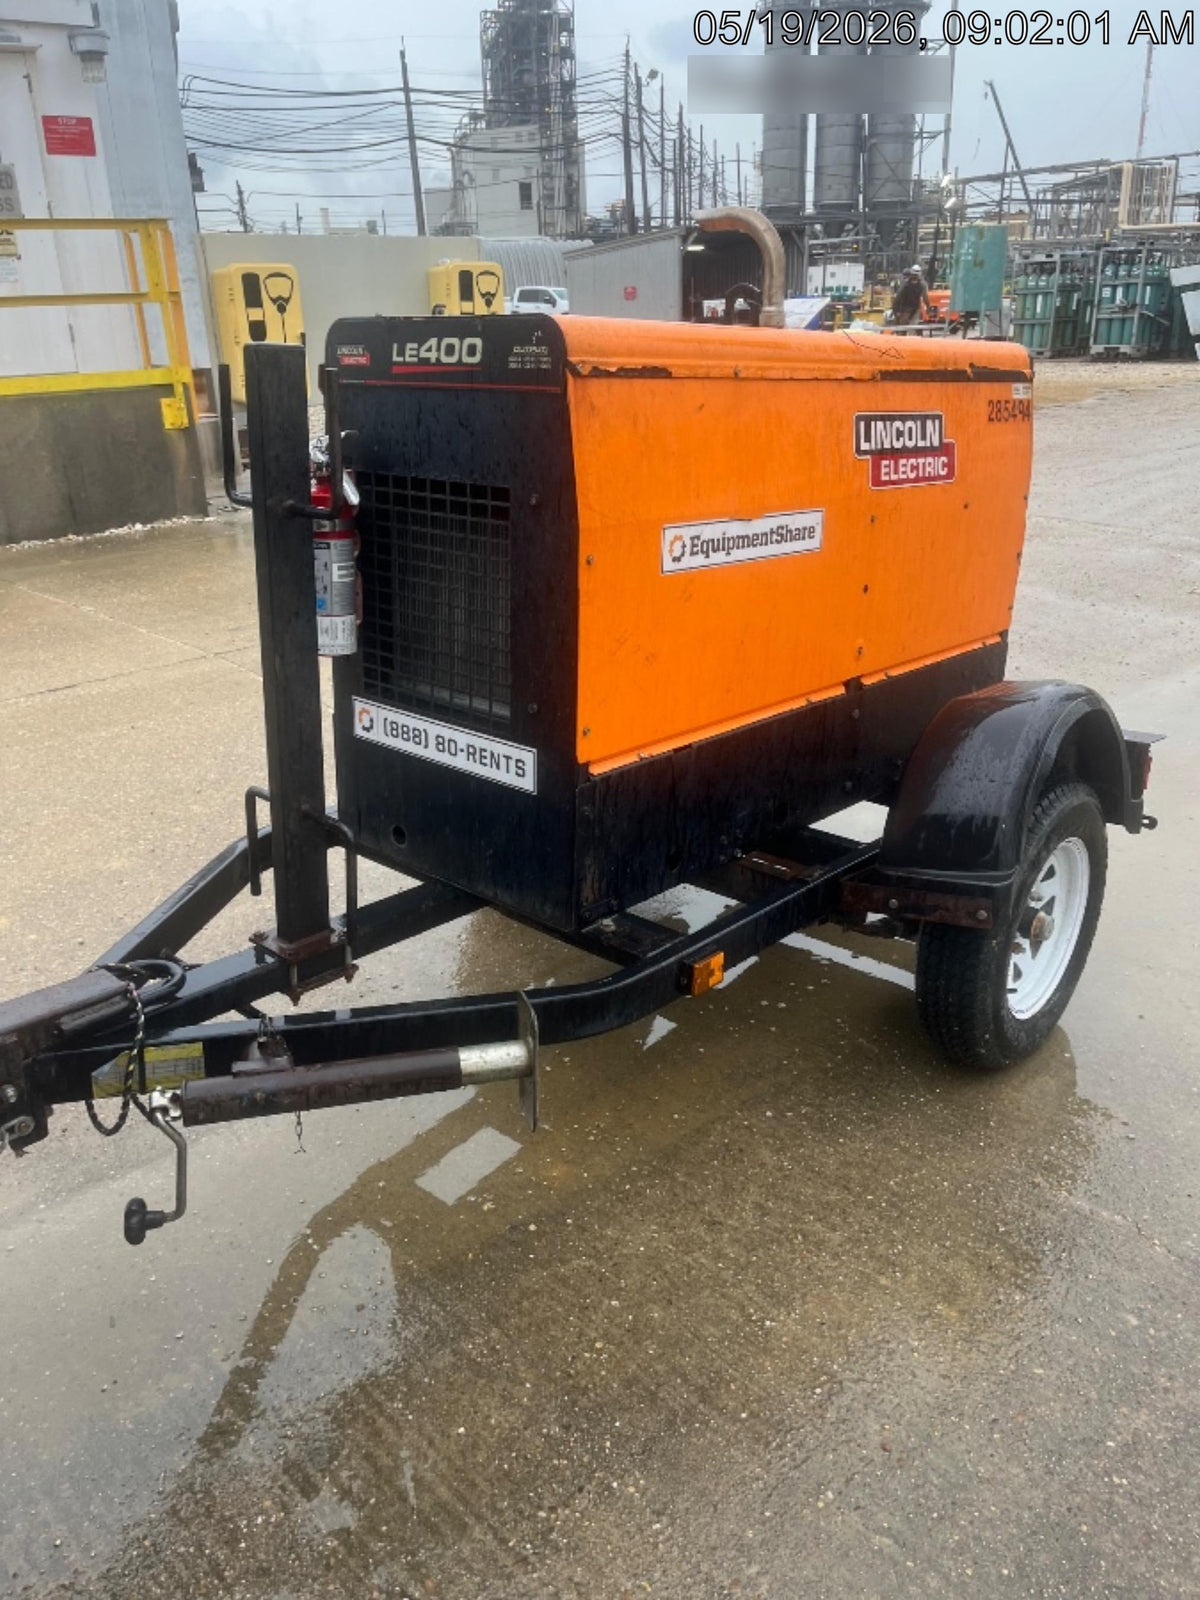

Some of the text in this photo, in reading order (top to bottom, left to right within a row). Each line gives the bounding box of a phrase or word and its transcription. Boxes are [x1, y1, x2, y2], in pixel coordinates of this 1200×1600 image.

[392, 337, 483, 364] LE400
[987, 399, 1031, 423] 285494
[858, 418, 941, 452] LINCOLN
[880, 456, 949, 481] ELECTRIC
[688, 522, 817, 559] EquipmentShare
[383, 717, 527, 778] (888) 80-RENTS
